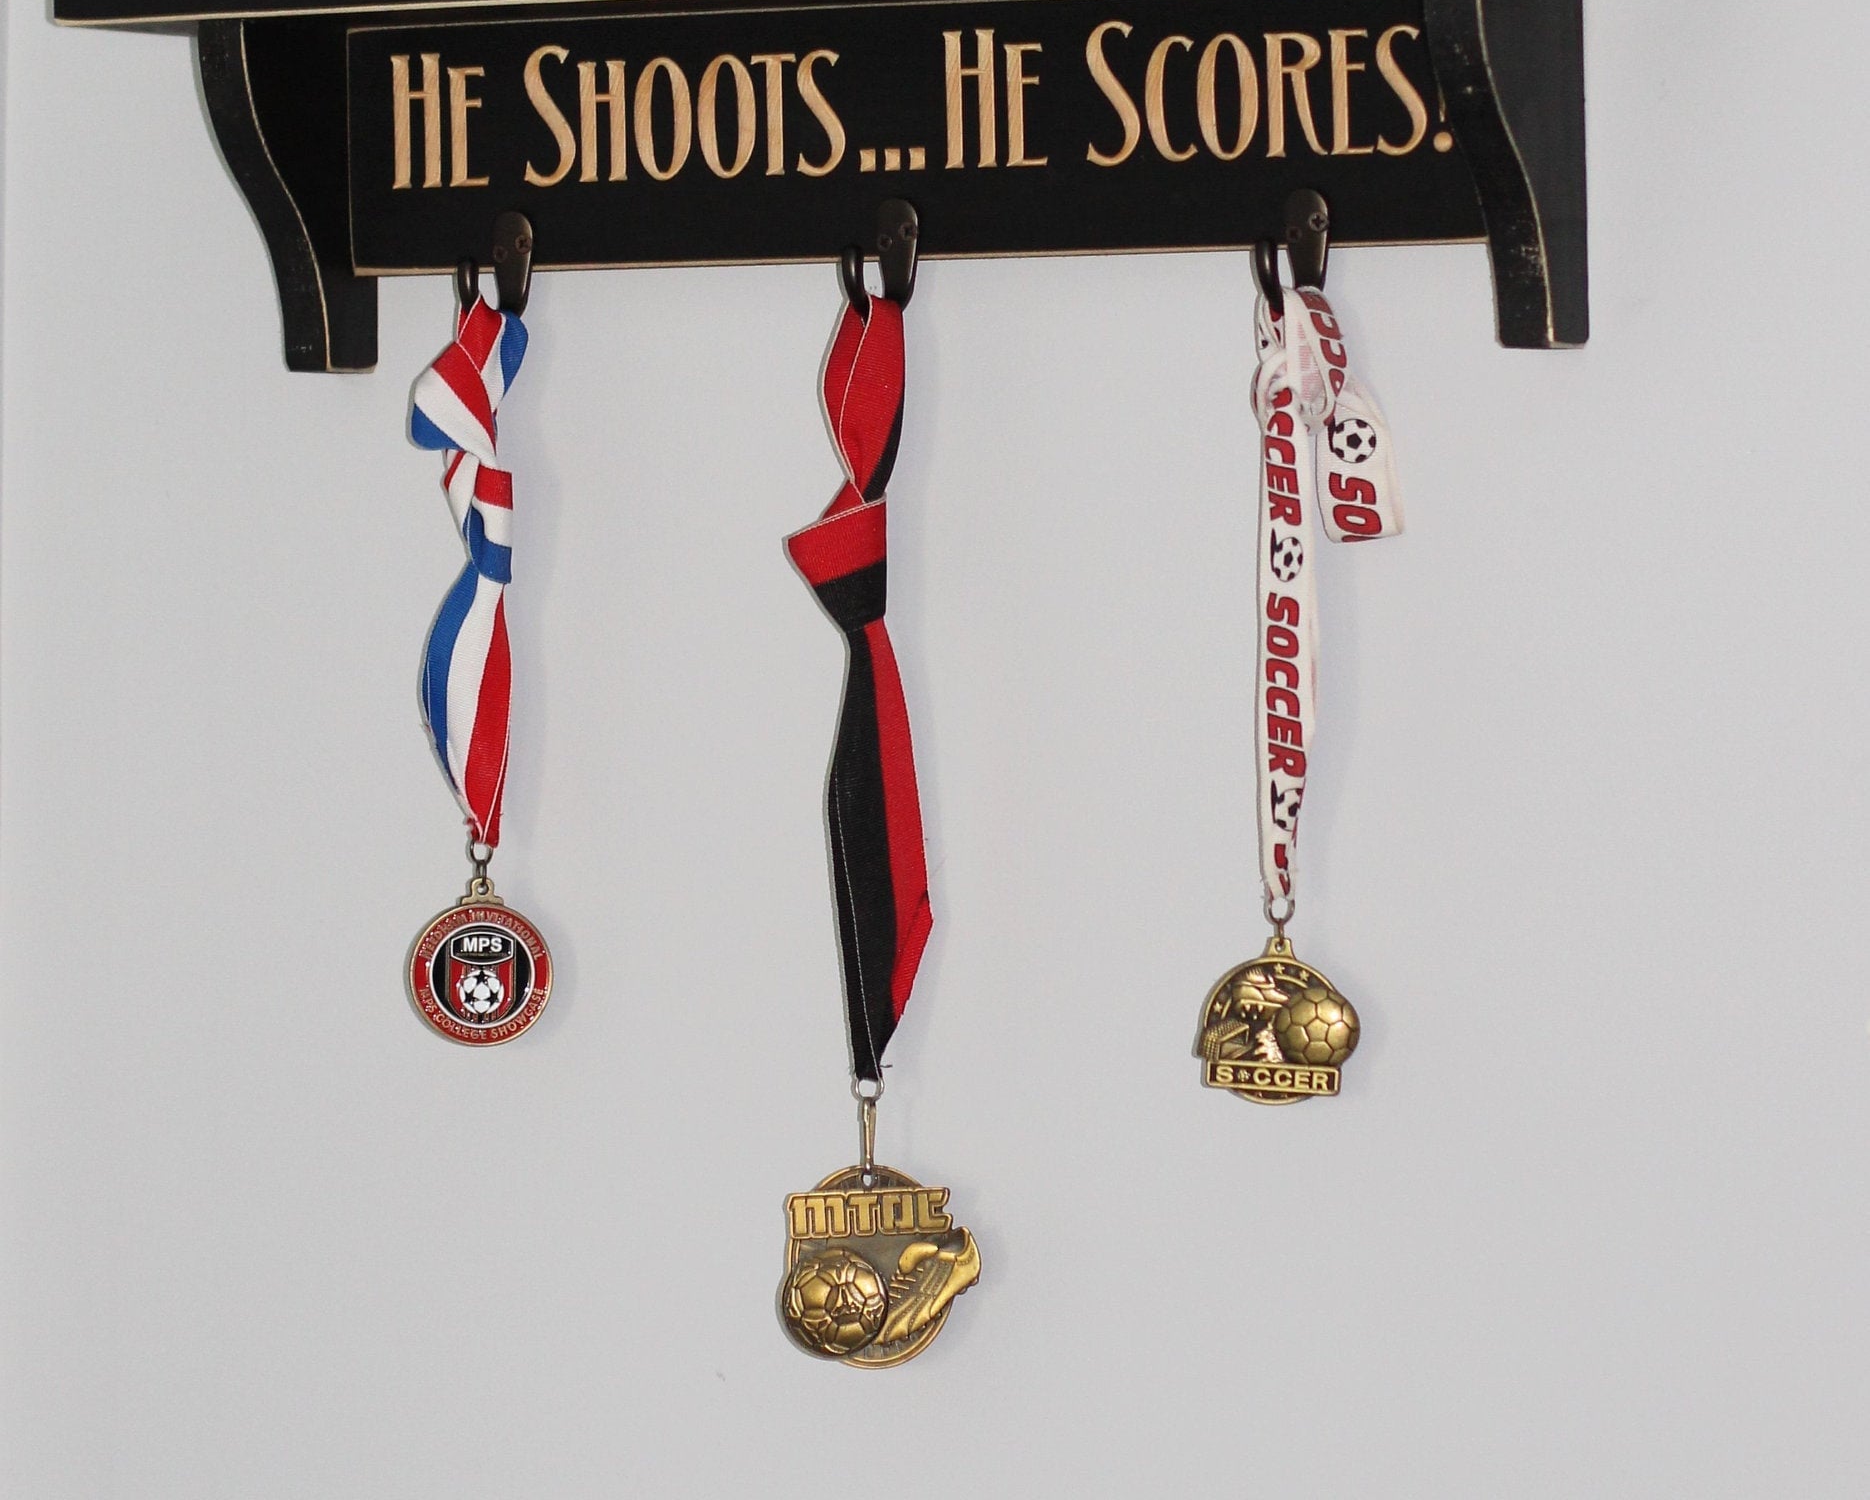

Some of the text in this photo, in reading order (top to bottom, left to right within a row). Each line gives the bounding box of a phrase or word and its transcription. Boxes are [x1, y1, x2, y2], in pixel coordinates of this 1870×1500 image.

[390, 52, 490, 190] HE
[942, 28, 1049, 170] HE
[1265, 592, 1307, 778] SOCCER
[463, 936, 503, 953] MPS
[435, 1013, 488, 1040] COLLEGE
[490, 987, 545, 1039] SHOWCASE
